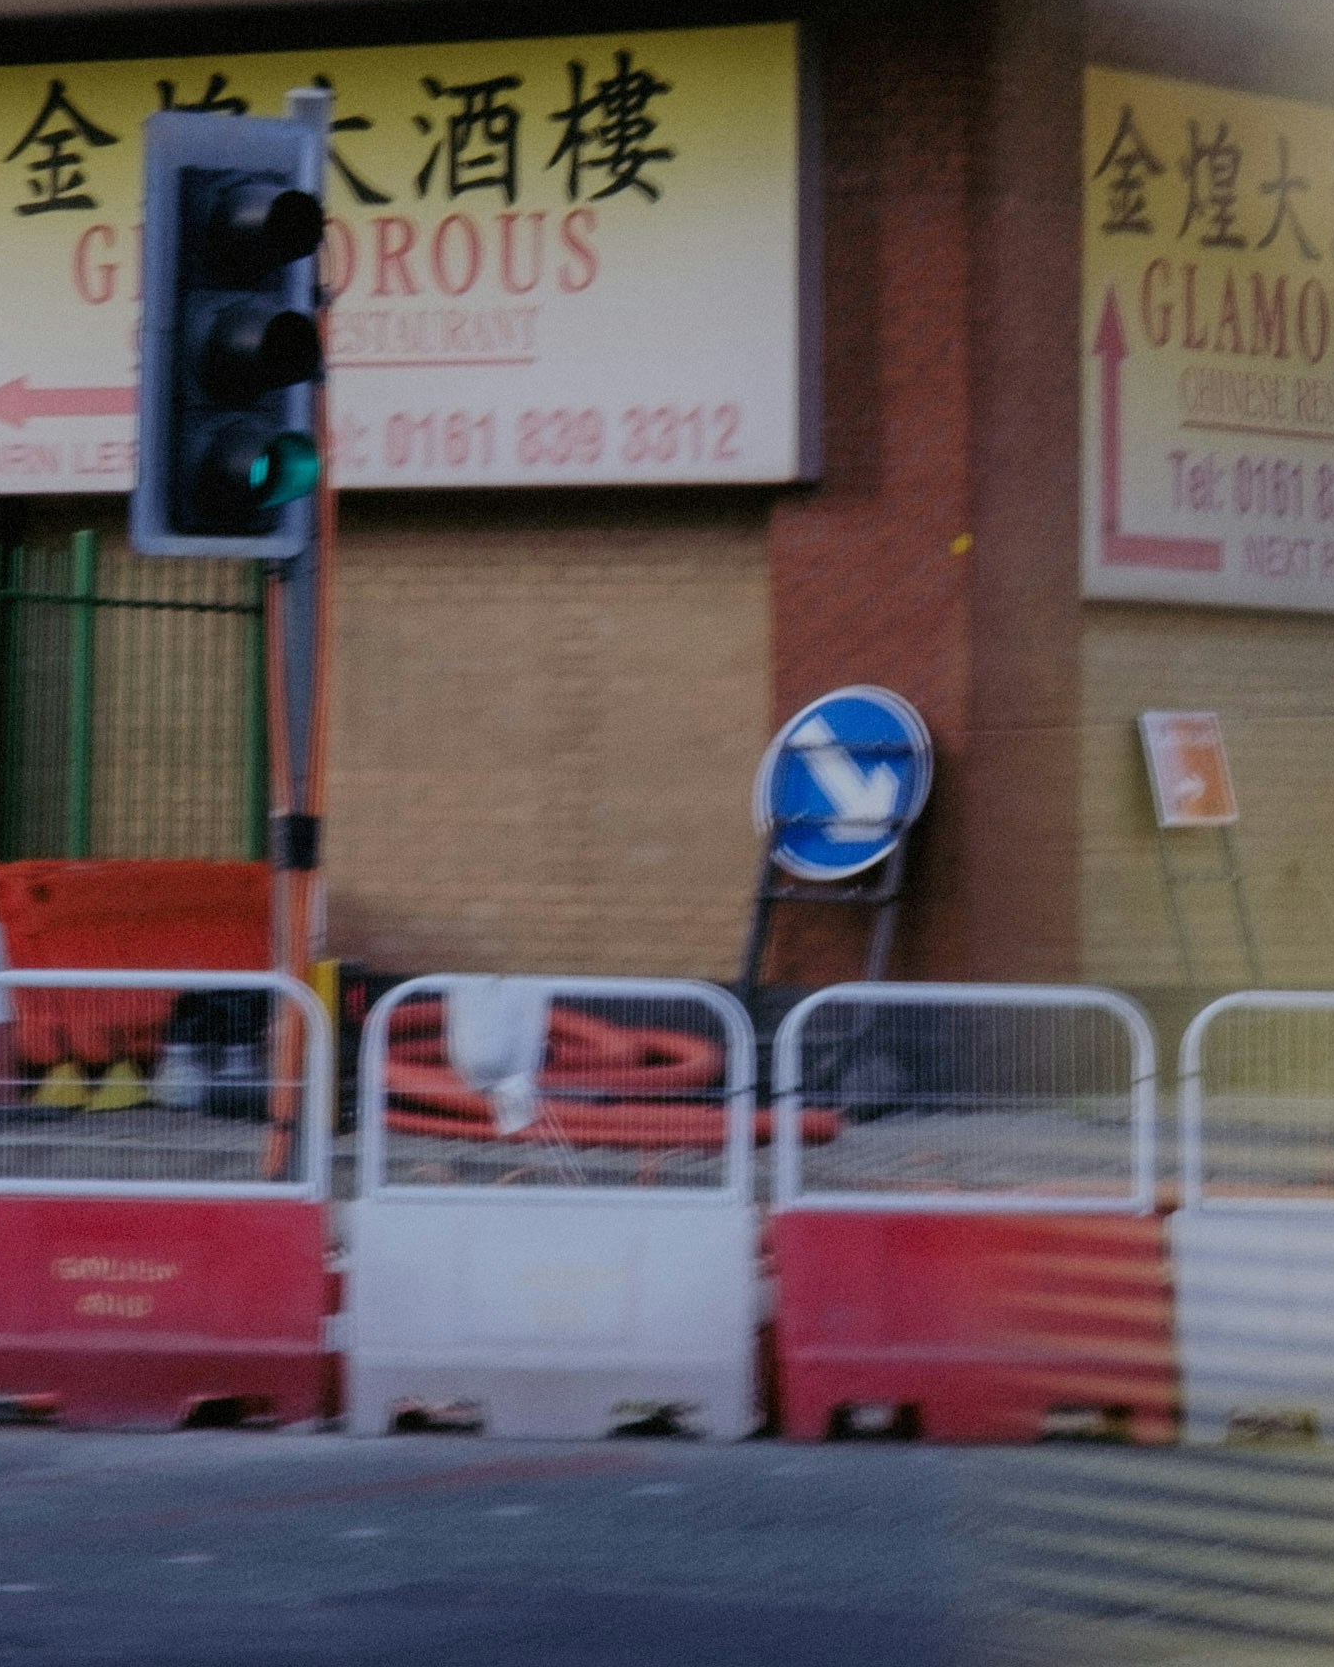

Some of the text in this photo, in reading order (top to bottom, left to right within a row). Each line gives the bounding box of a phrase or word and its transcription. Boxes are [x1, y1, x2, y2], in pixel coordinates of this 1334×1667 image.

[4, 49, 676, 216] 金酒樓
[73, 207, 600, 305] GOROUS
[384, 409, 497, 467] 0161
[619, 401, 742, 463] 3312
